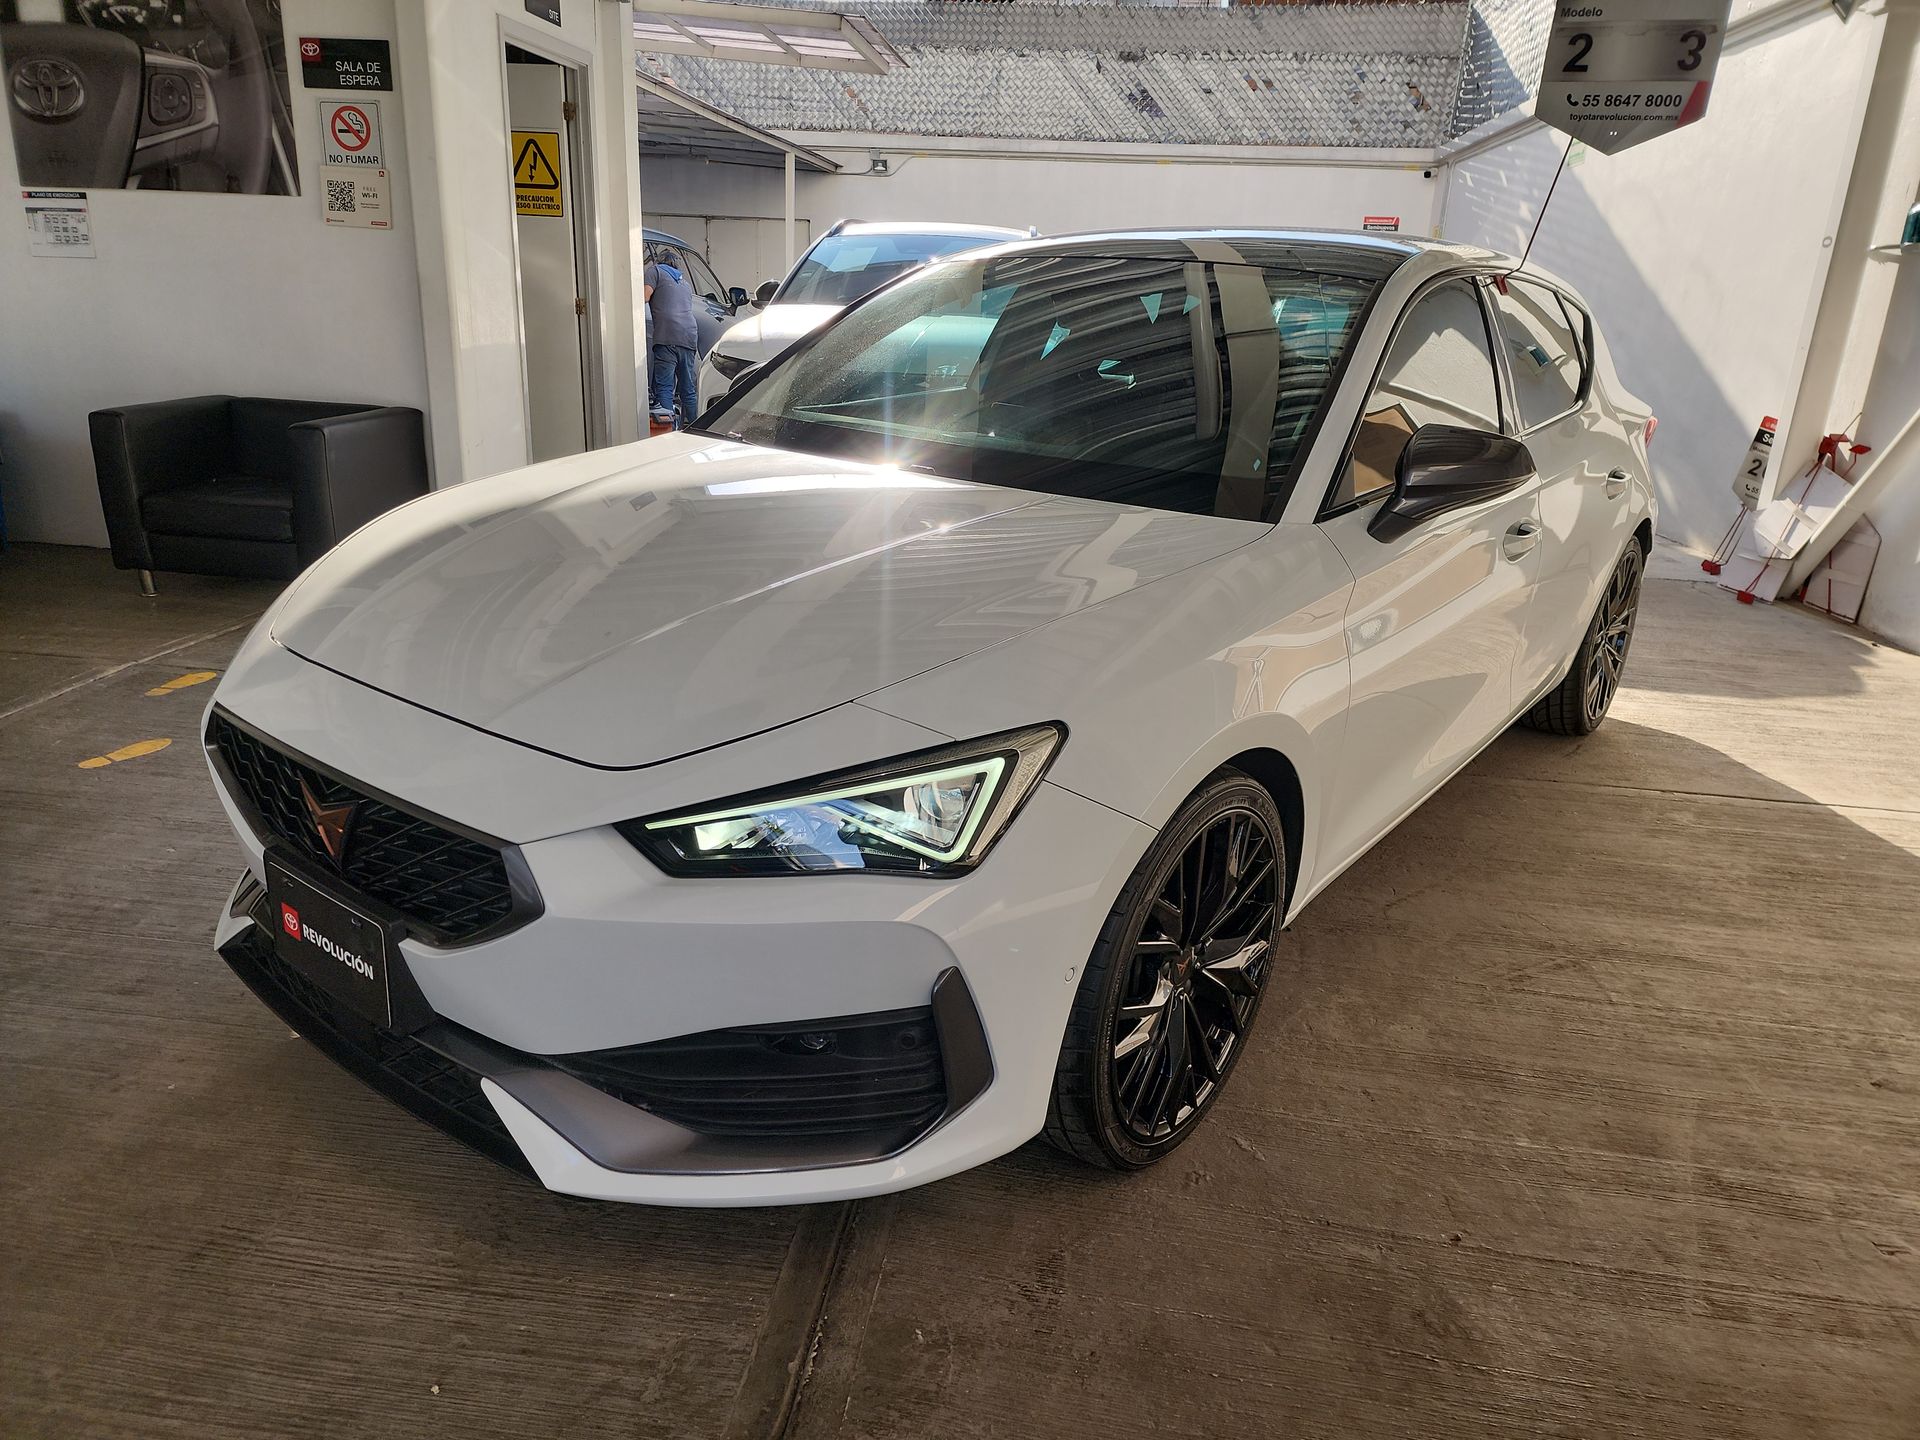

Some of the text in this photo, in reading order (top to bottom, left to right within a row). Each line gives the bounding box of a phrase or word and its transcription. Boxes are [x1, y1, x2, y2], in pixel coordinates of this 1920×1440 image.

[548, 9, 560, 22] SITE
[1560, 7, 1603, 18] Modelo
[335, 61, 381, 73] SALA DE
[339, 75, 381, 86] ESPERA
[1582, 94, 1682, 107] 55 8647 8000
[1569, 113, 1679, 122] toyotarevolucion.com.mx
[329, 154, 379, 165] NO FUMAR
[516, 194, 555, 203] PRECAUCION
[532, 203, 561, 211] ELECTRICO
[302, 923, 374, 981] REVOLUCIÓN
